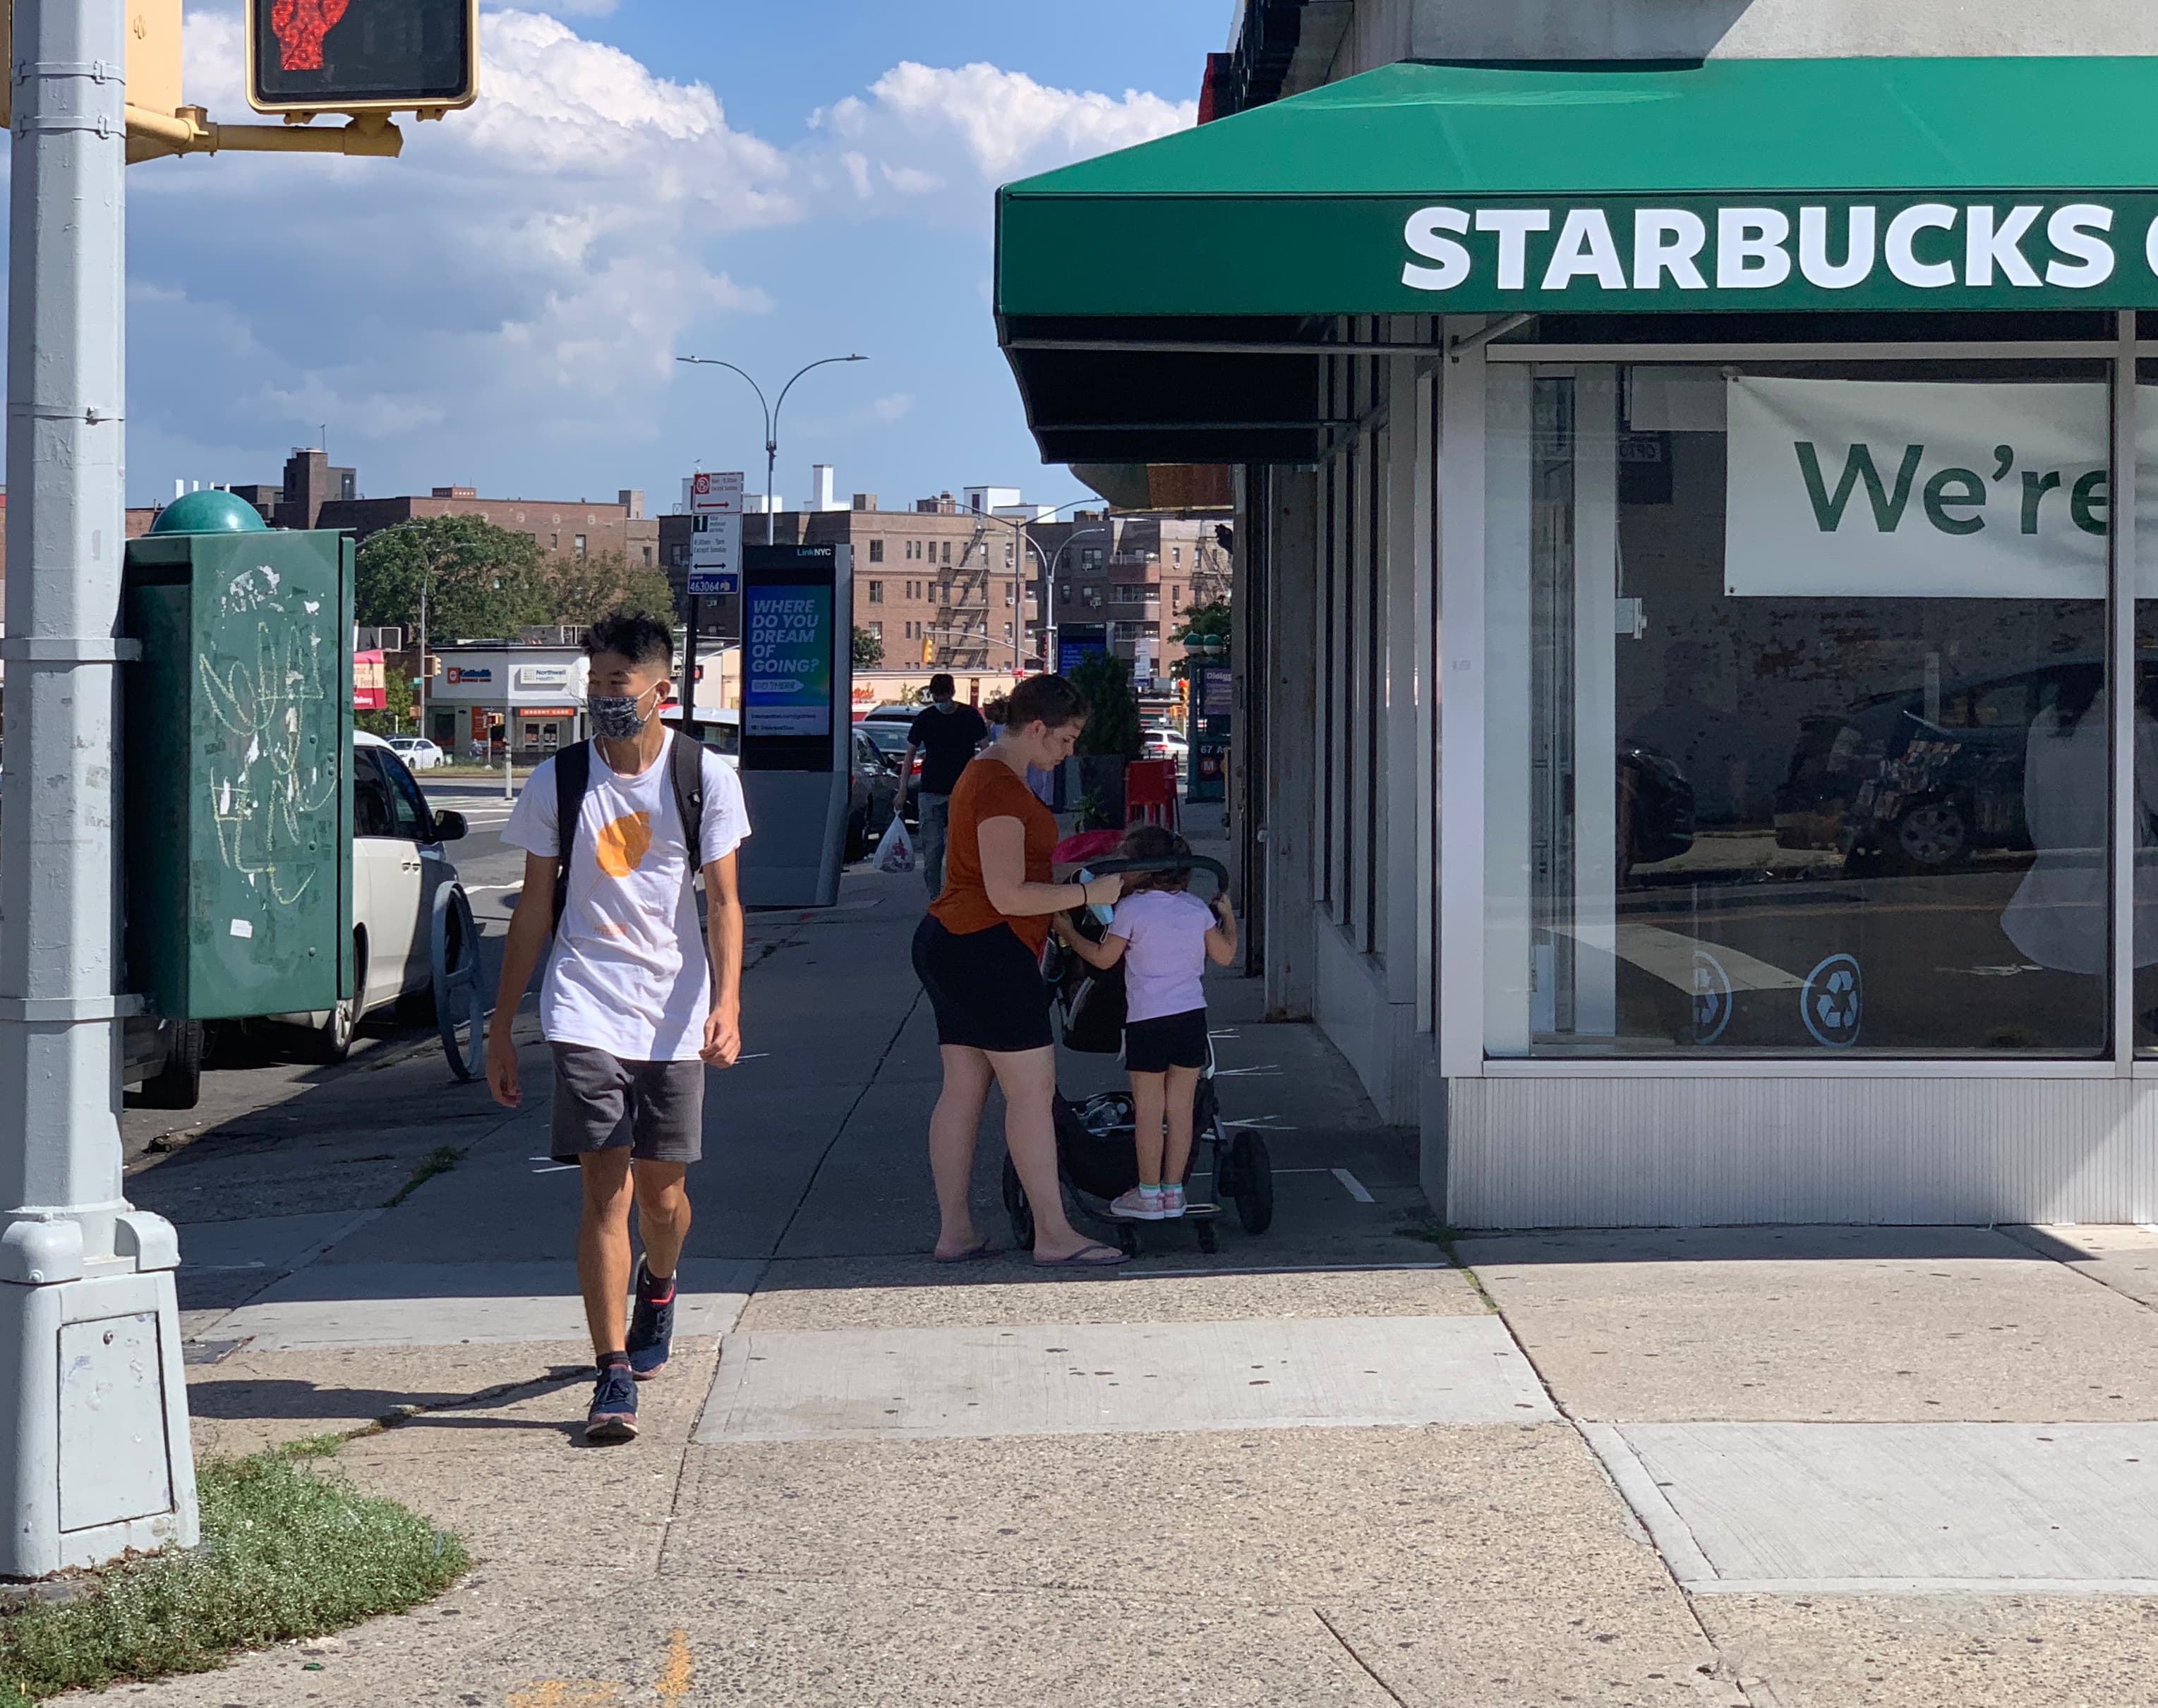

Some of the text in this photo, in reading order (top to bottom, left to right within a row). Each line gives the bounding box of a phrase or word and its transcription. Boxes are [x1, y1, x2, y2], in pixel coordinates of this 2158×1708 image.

[1401, 203, 2114, 291] STARBUCKS
[1793, 441, 2107, 535] We're
[797, 548, 832, 557] LinkNYC
[689, 581, 720, 592] 463064
[754, 600, 815, 614] WHERE
[752, 614, 819, 629] DO YOU
[752, 629, 815, 643] DREAM
[752, 644, 776, 658] OF
[752, 659, 820, 673] GOING?
[1203, 761, 1214, 770] M
